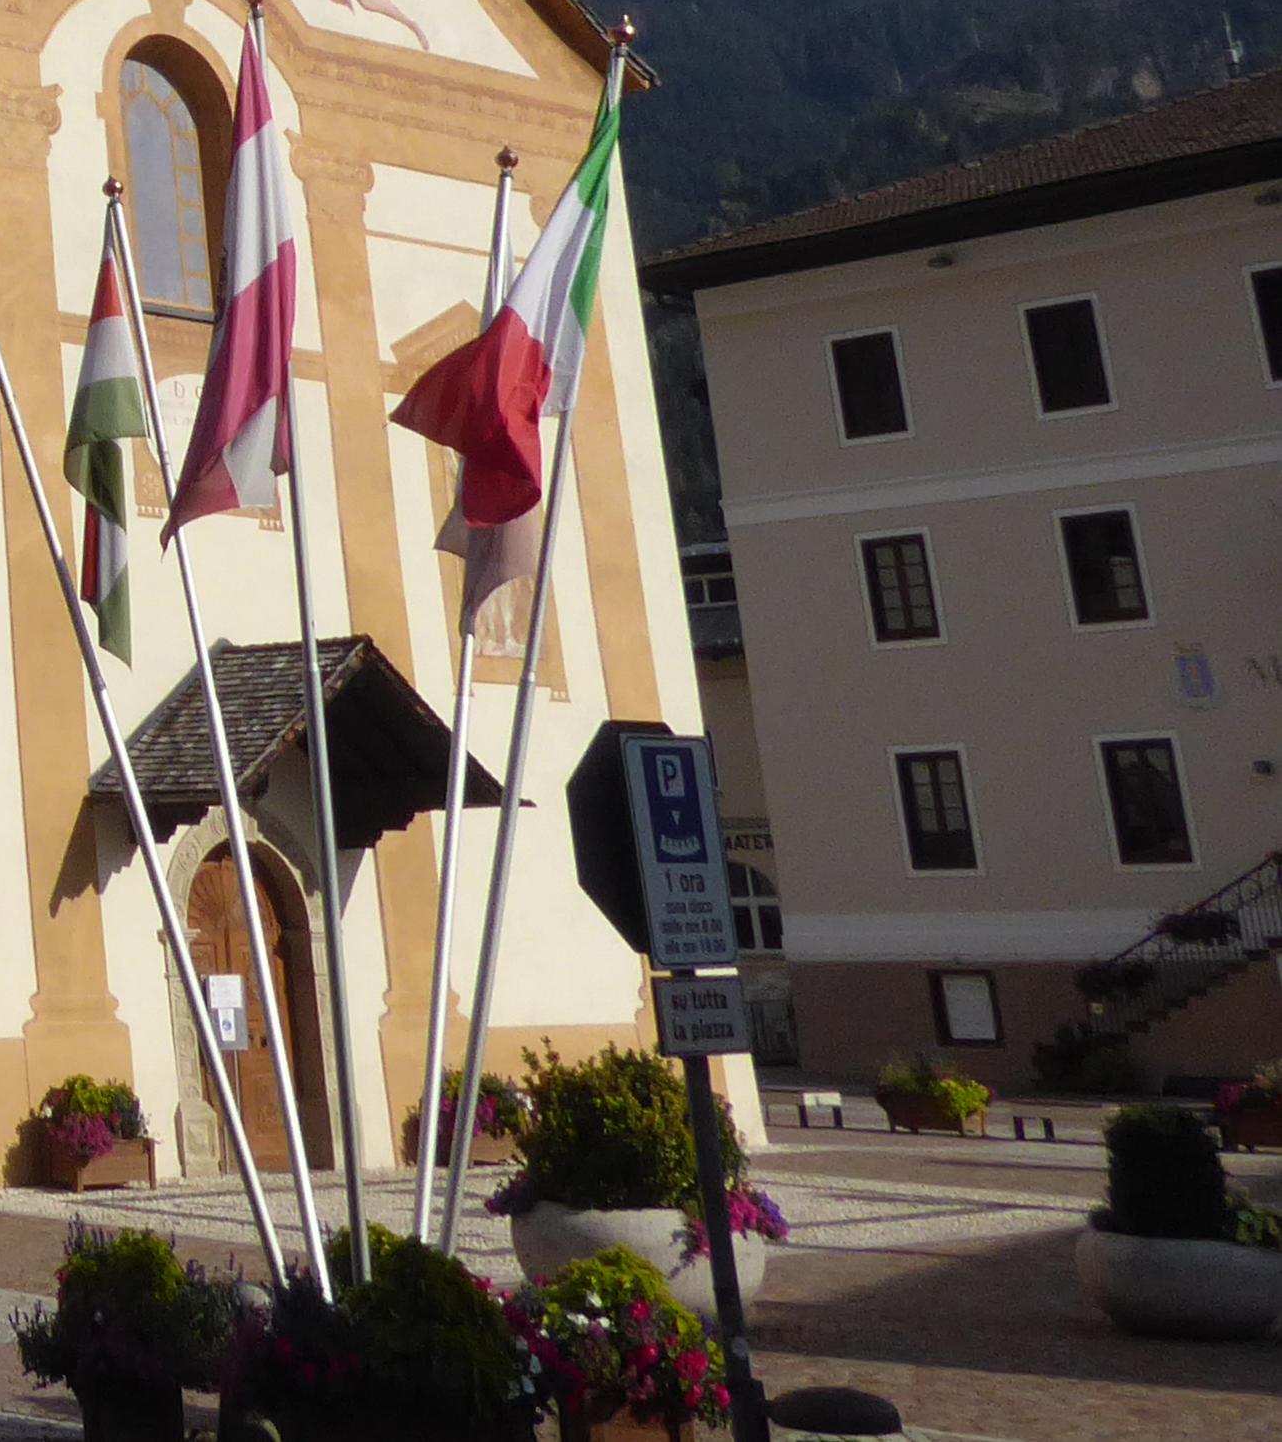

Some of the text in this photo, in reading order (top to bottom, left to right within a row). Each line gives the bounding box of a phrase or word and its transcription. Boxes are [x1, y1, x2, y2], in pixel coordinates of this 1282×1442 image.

[661, 759, 677, 793] P
[664, 868, 706, 893] 1 ora
[691, 989, 728, 1010] tutta
[672, 1018, 735, 1043] la piazza
